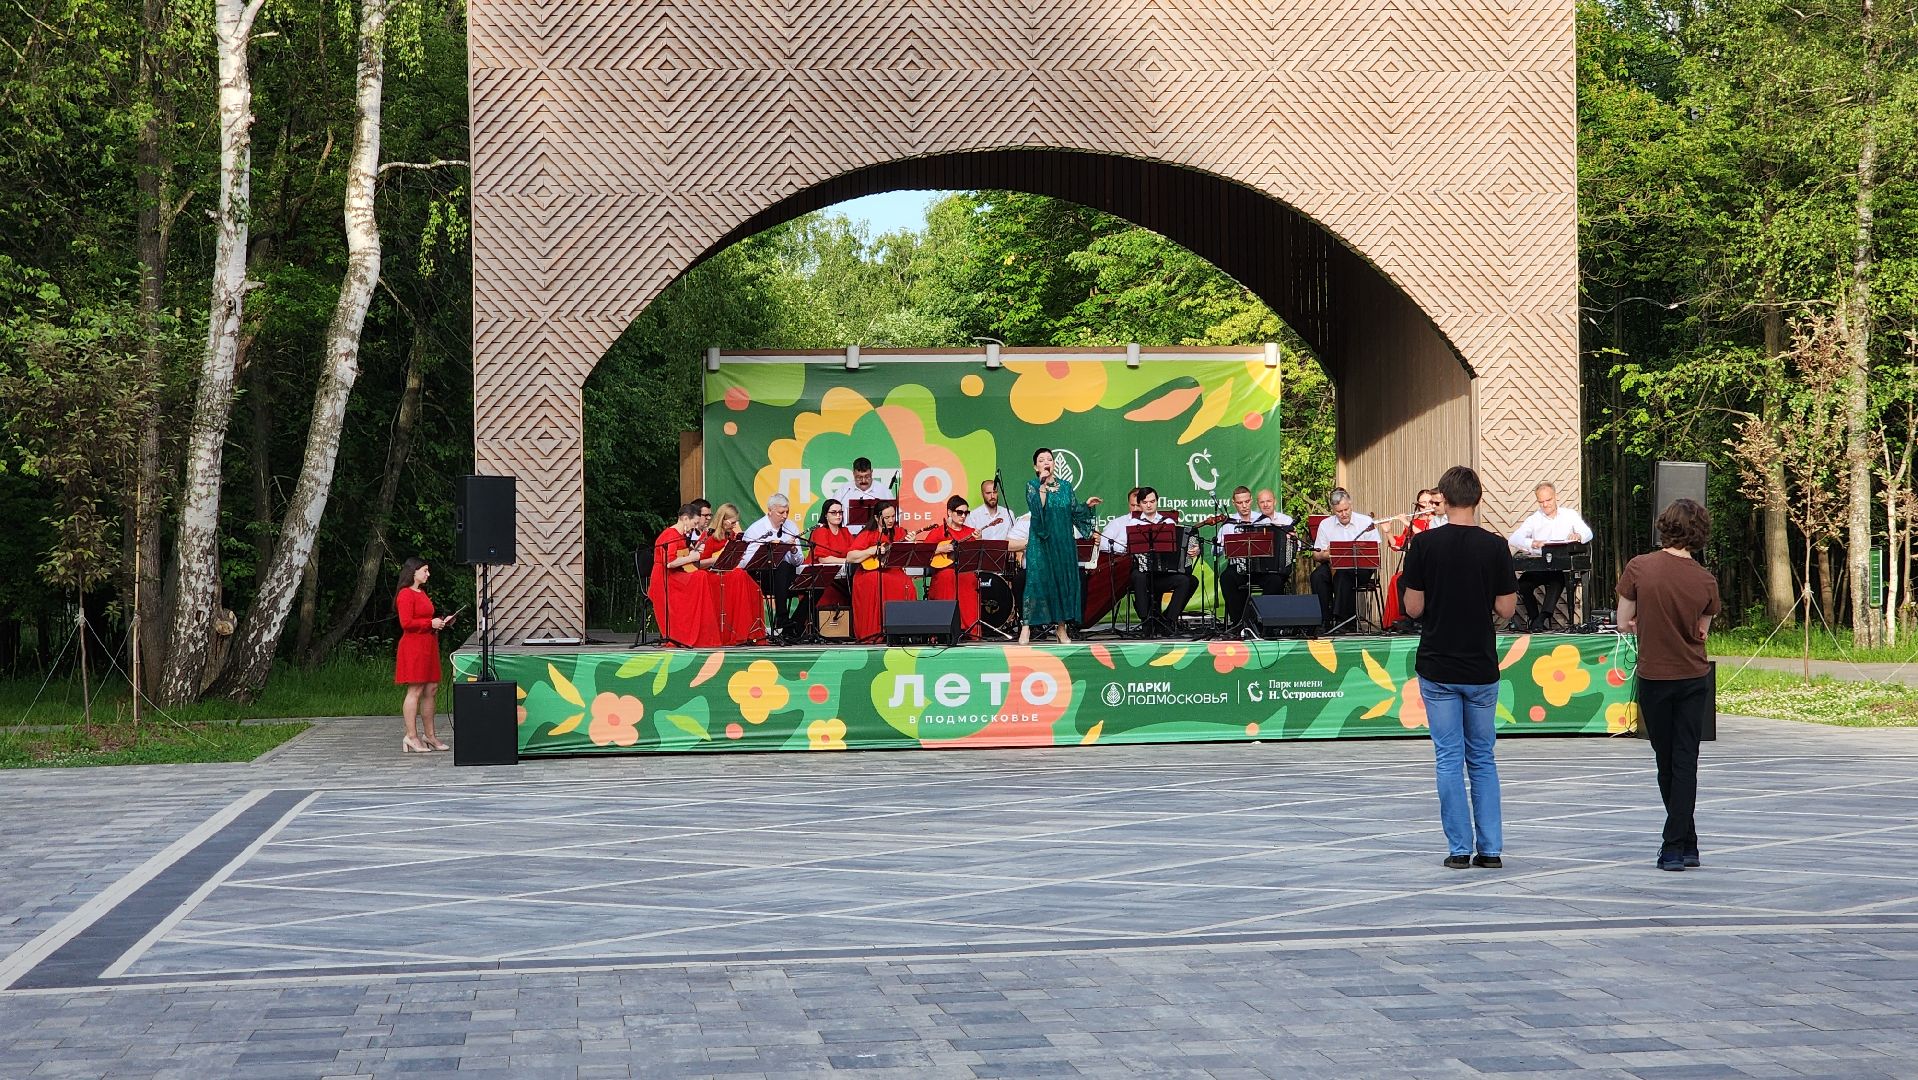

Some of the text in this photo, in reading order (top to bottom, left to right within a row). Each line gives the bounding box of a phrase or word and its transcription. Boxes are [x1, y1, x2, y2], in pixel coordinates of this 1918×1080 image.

[1157, 496, 1188, 510] Парк
[888, 671, 1058, 708] лето
[1127, 682, 1171, 693] ПАРКИ
[1269, 680, 1323, 690] Парк имени
[1127, 693, 1228, 705] ПОДМОСКОВЬЯ
[1269, 689, 1344, 700] Н. Островского
[909, 714, 1039, 724] В ПОДМОСКОВЬЕ
